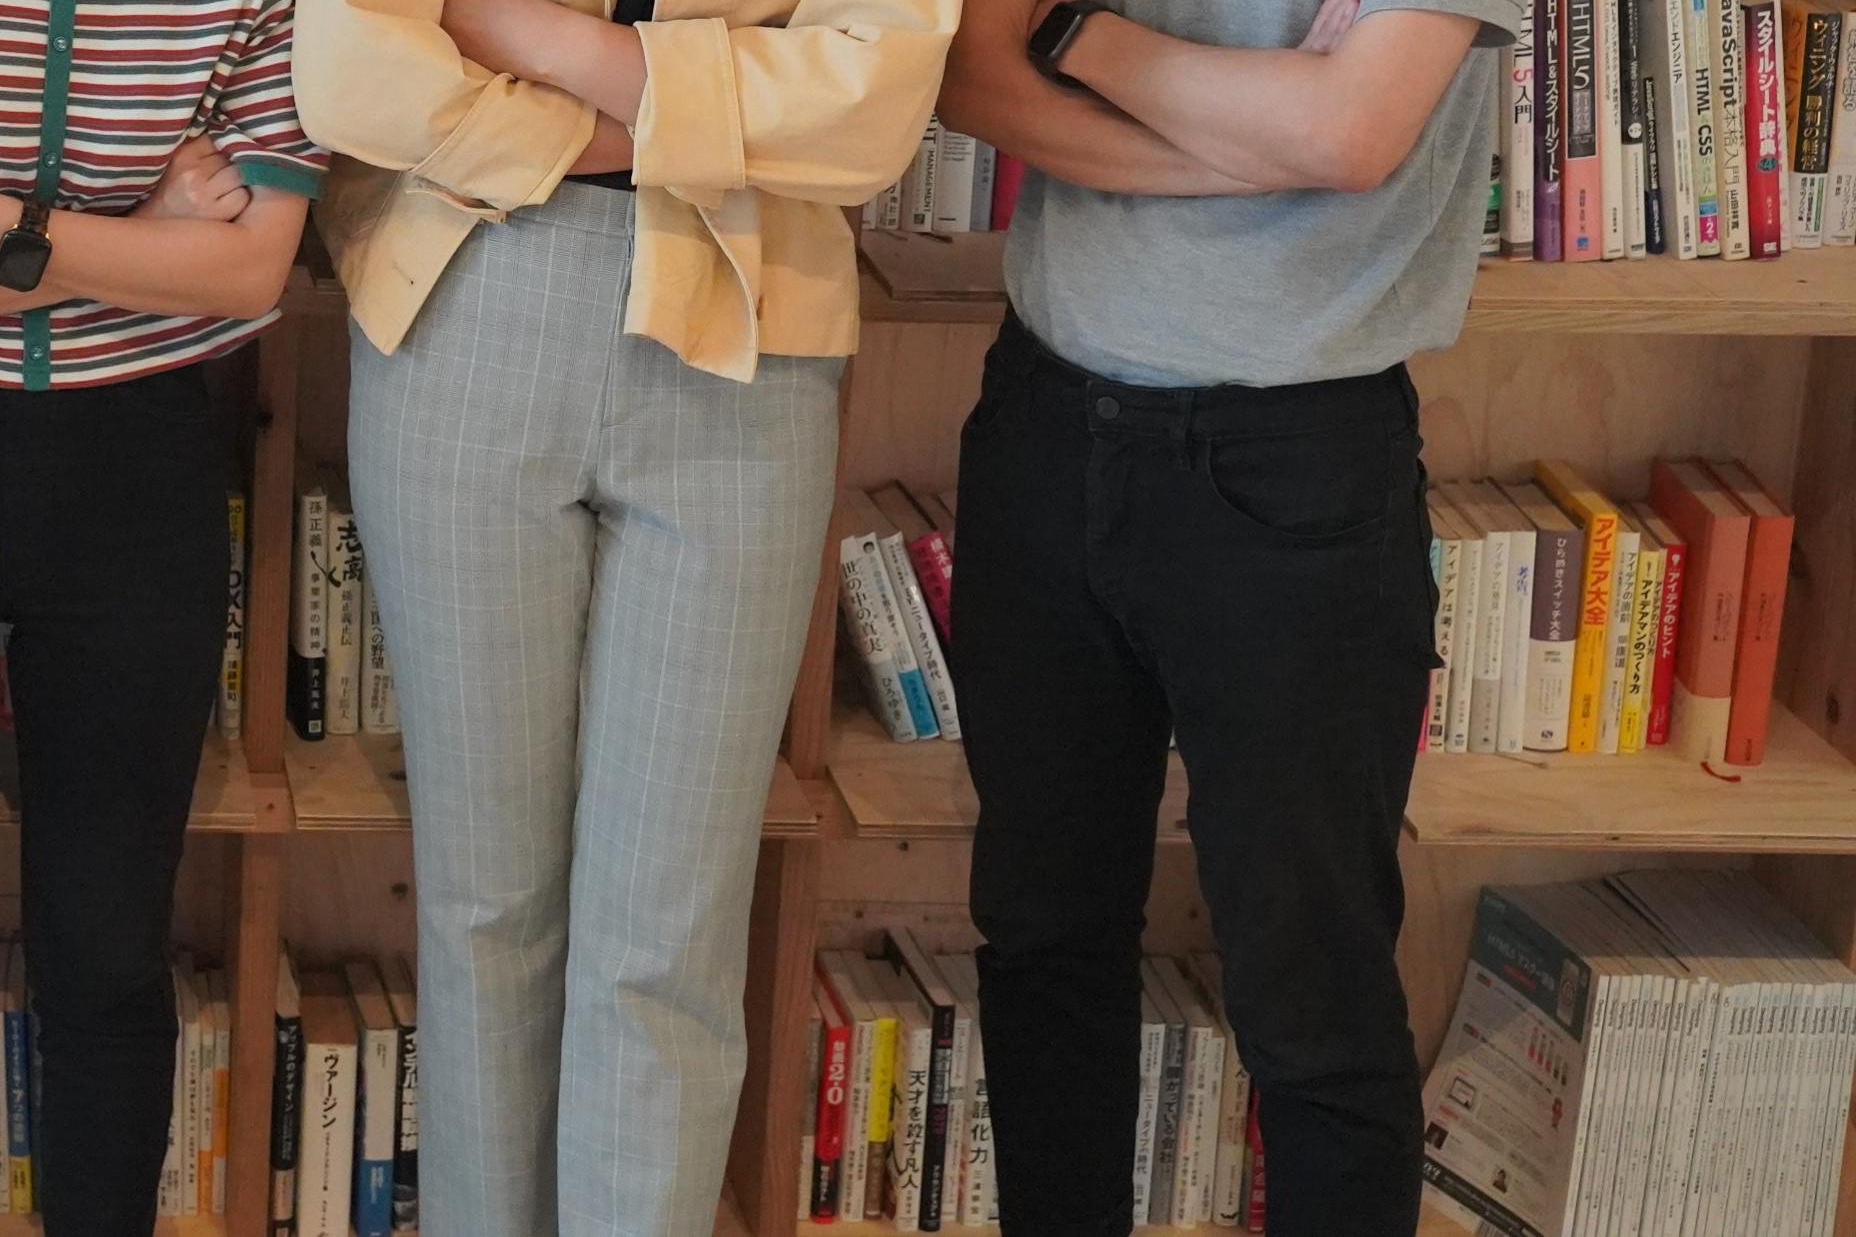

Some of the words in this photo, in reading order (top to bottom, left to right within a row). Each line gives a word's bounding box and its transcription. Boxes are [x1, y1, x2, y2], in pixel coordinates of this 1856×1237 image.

[1571, 2, 1591, 91] HTML5
[1756, 11, 1778, 157] スタイルシート辞典
[1808, 20, 1829, 91] ウィニング
[1800, 95, 1824, 172] 勝利の経営
[923, 150, 936, 212] MANAGEMENT
[308, 501, 323, 547] 孫正義
[1584, 518, 1615, 627] アイデア大全
[1661, 570, 1682, 659] アイデアのヒント
[1628, 579, 1653, 696] アイデアマンのつくり方
[322, 1053, 341, 1130] ヴァージン
[901, 1068, 927, 1190] 天才を殺す凡人
